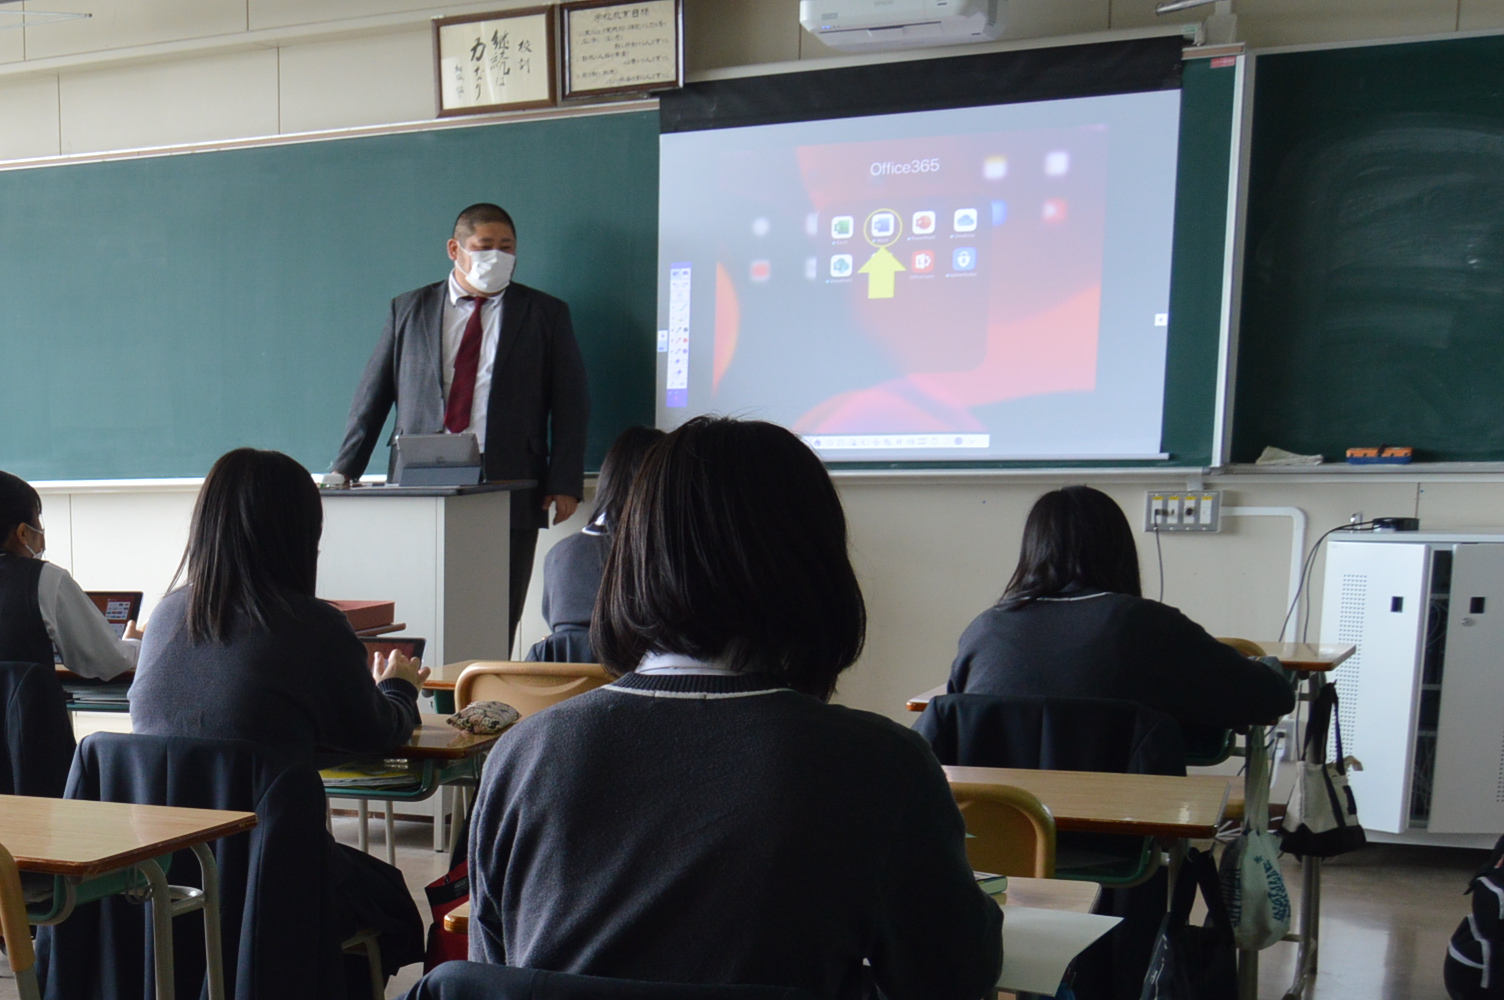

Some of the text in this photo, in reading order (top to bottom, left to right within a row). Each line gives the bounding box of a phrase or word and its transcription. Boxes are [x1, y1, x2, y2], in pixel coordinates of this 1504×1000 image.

[470, 36, 487, 101] 力なり
[870, 157, 940, 176] Office365
